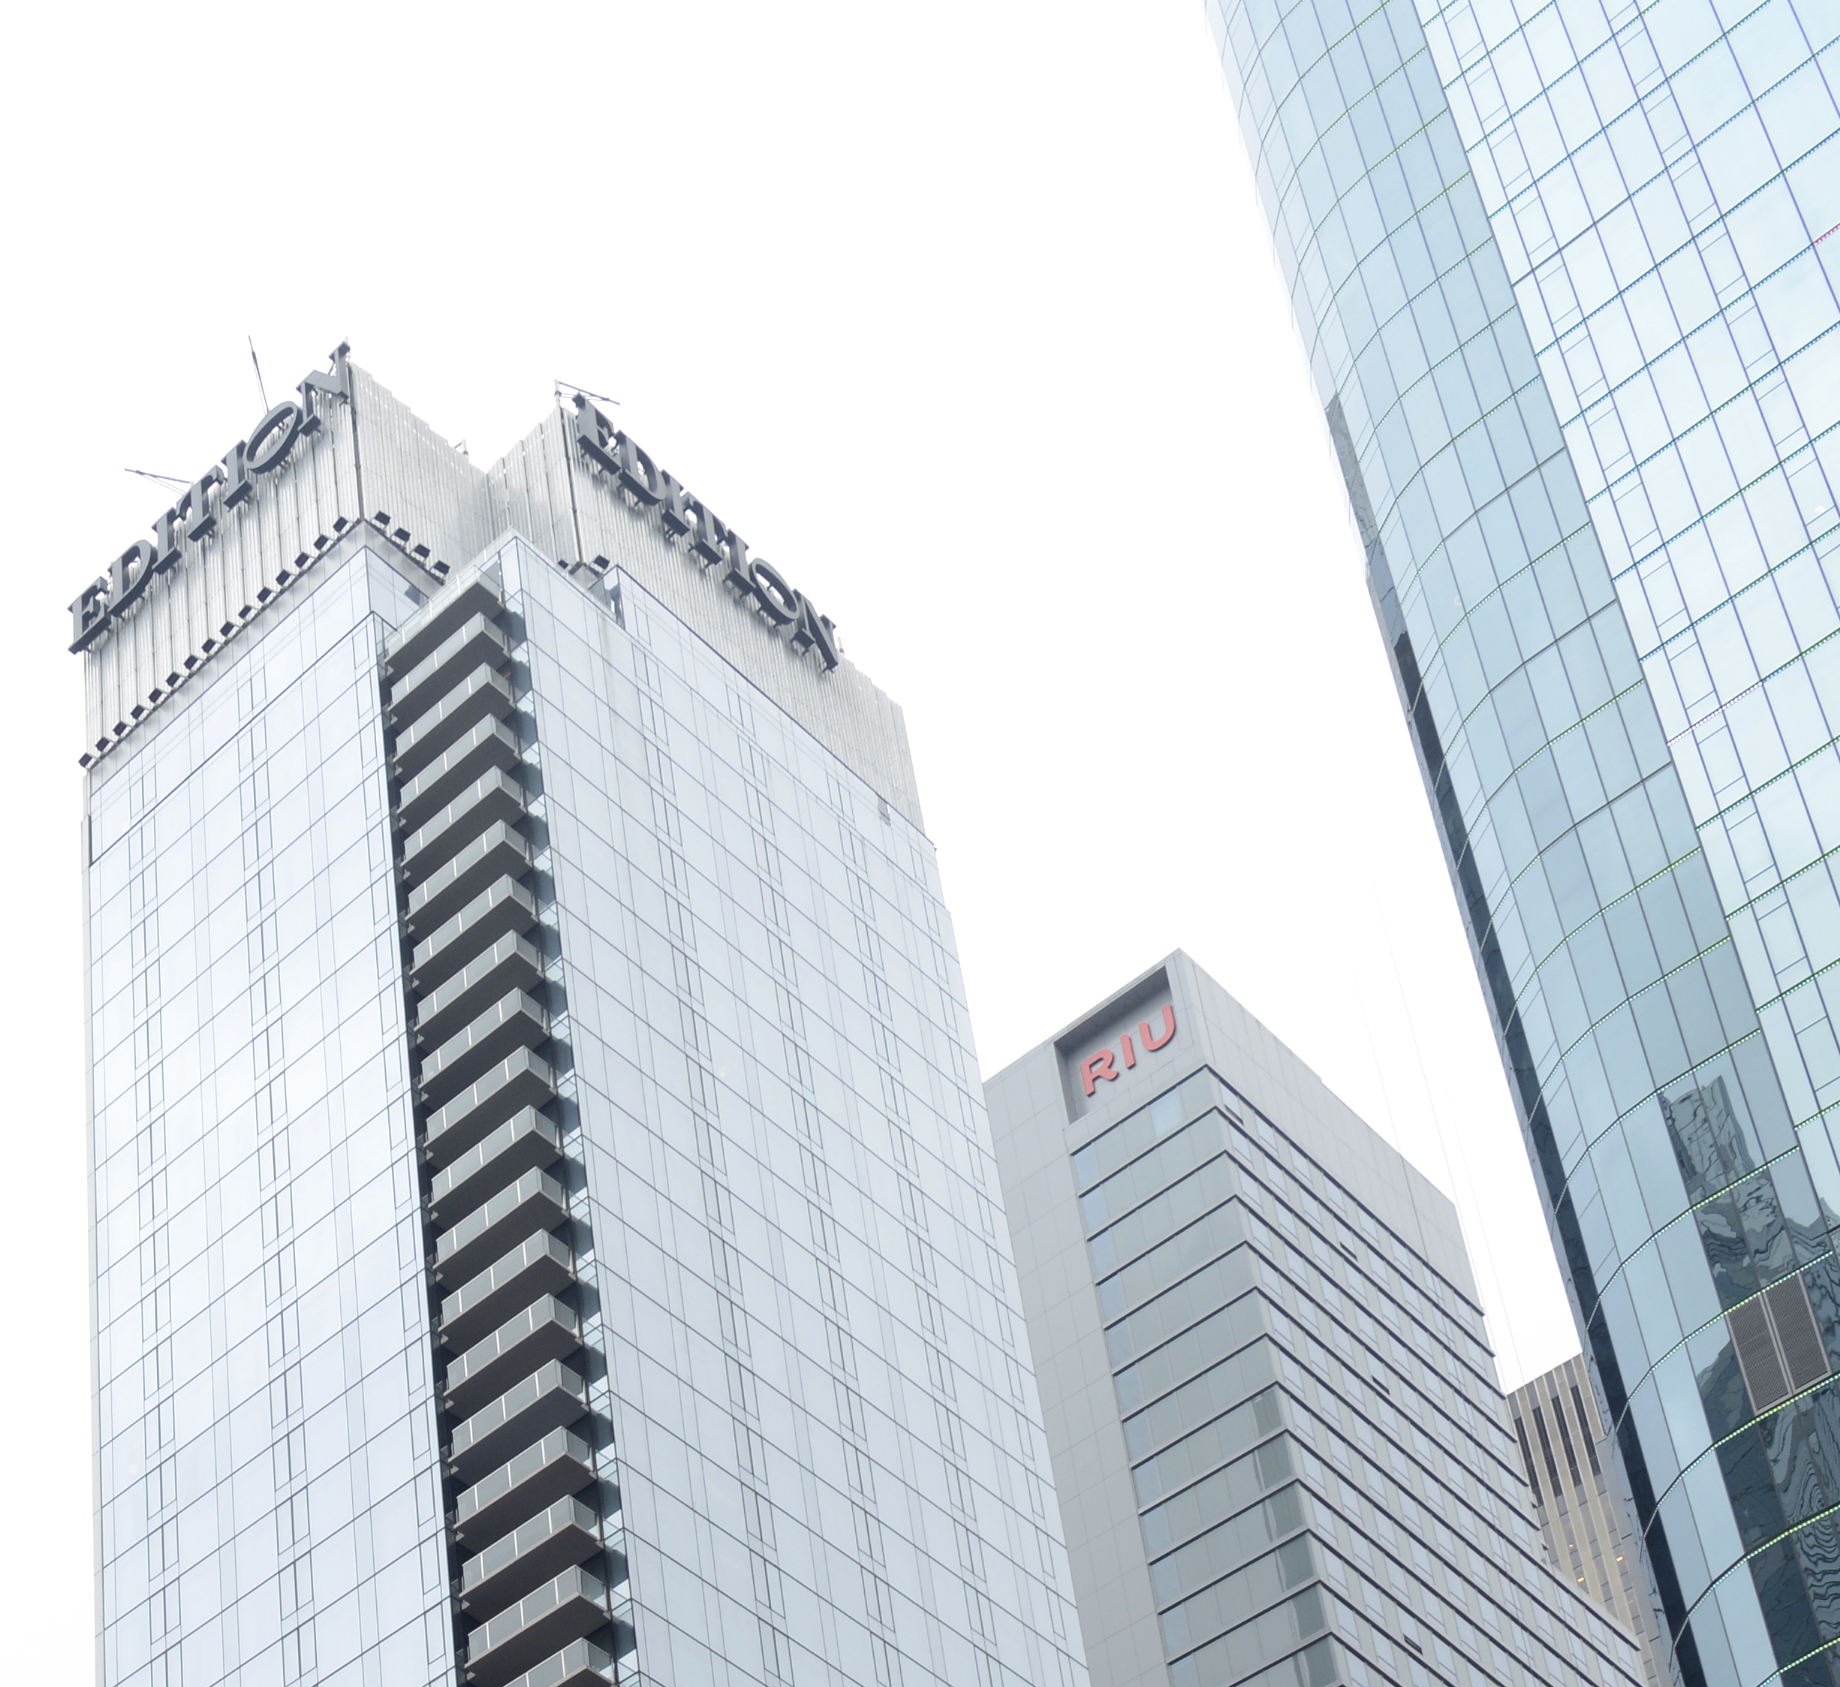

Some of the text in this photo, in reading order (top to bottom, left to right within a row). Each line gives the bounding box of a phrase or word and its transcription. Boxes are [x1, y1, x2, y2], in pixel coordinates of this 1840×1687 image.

[67, 341, 350, 654] EDITION
[572, 392, 839, 671] EDITION
[1079, 1003, 1177, 1098] RIU
